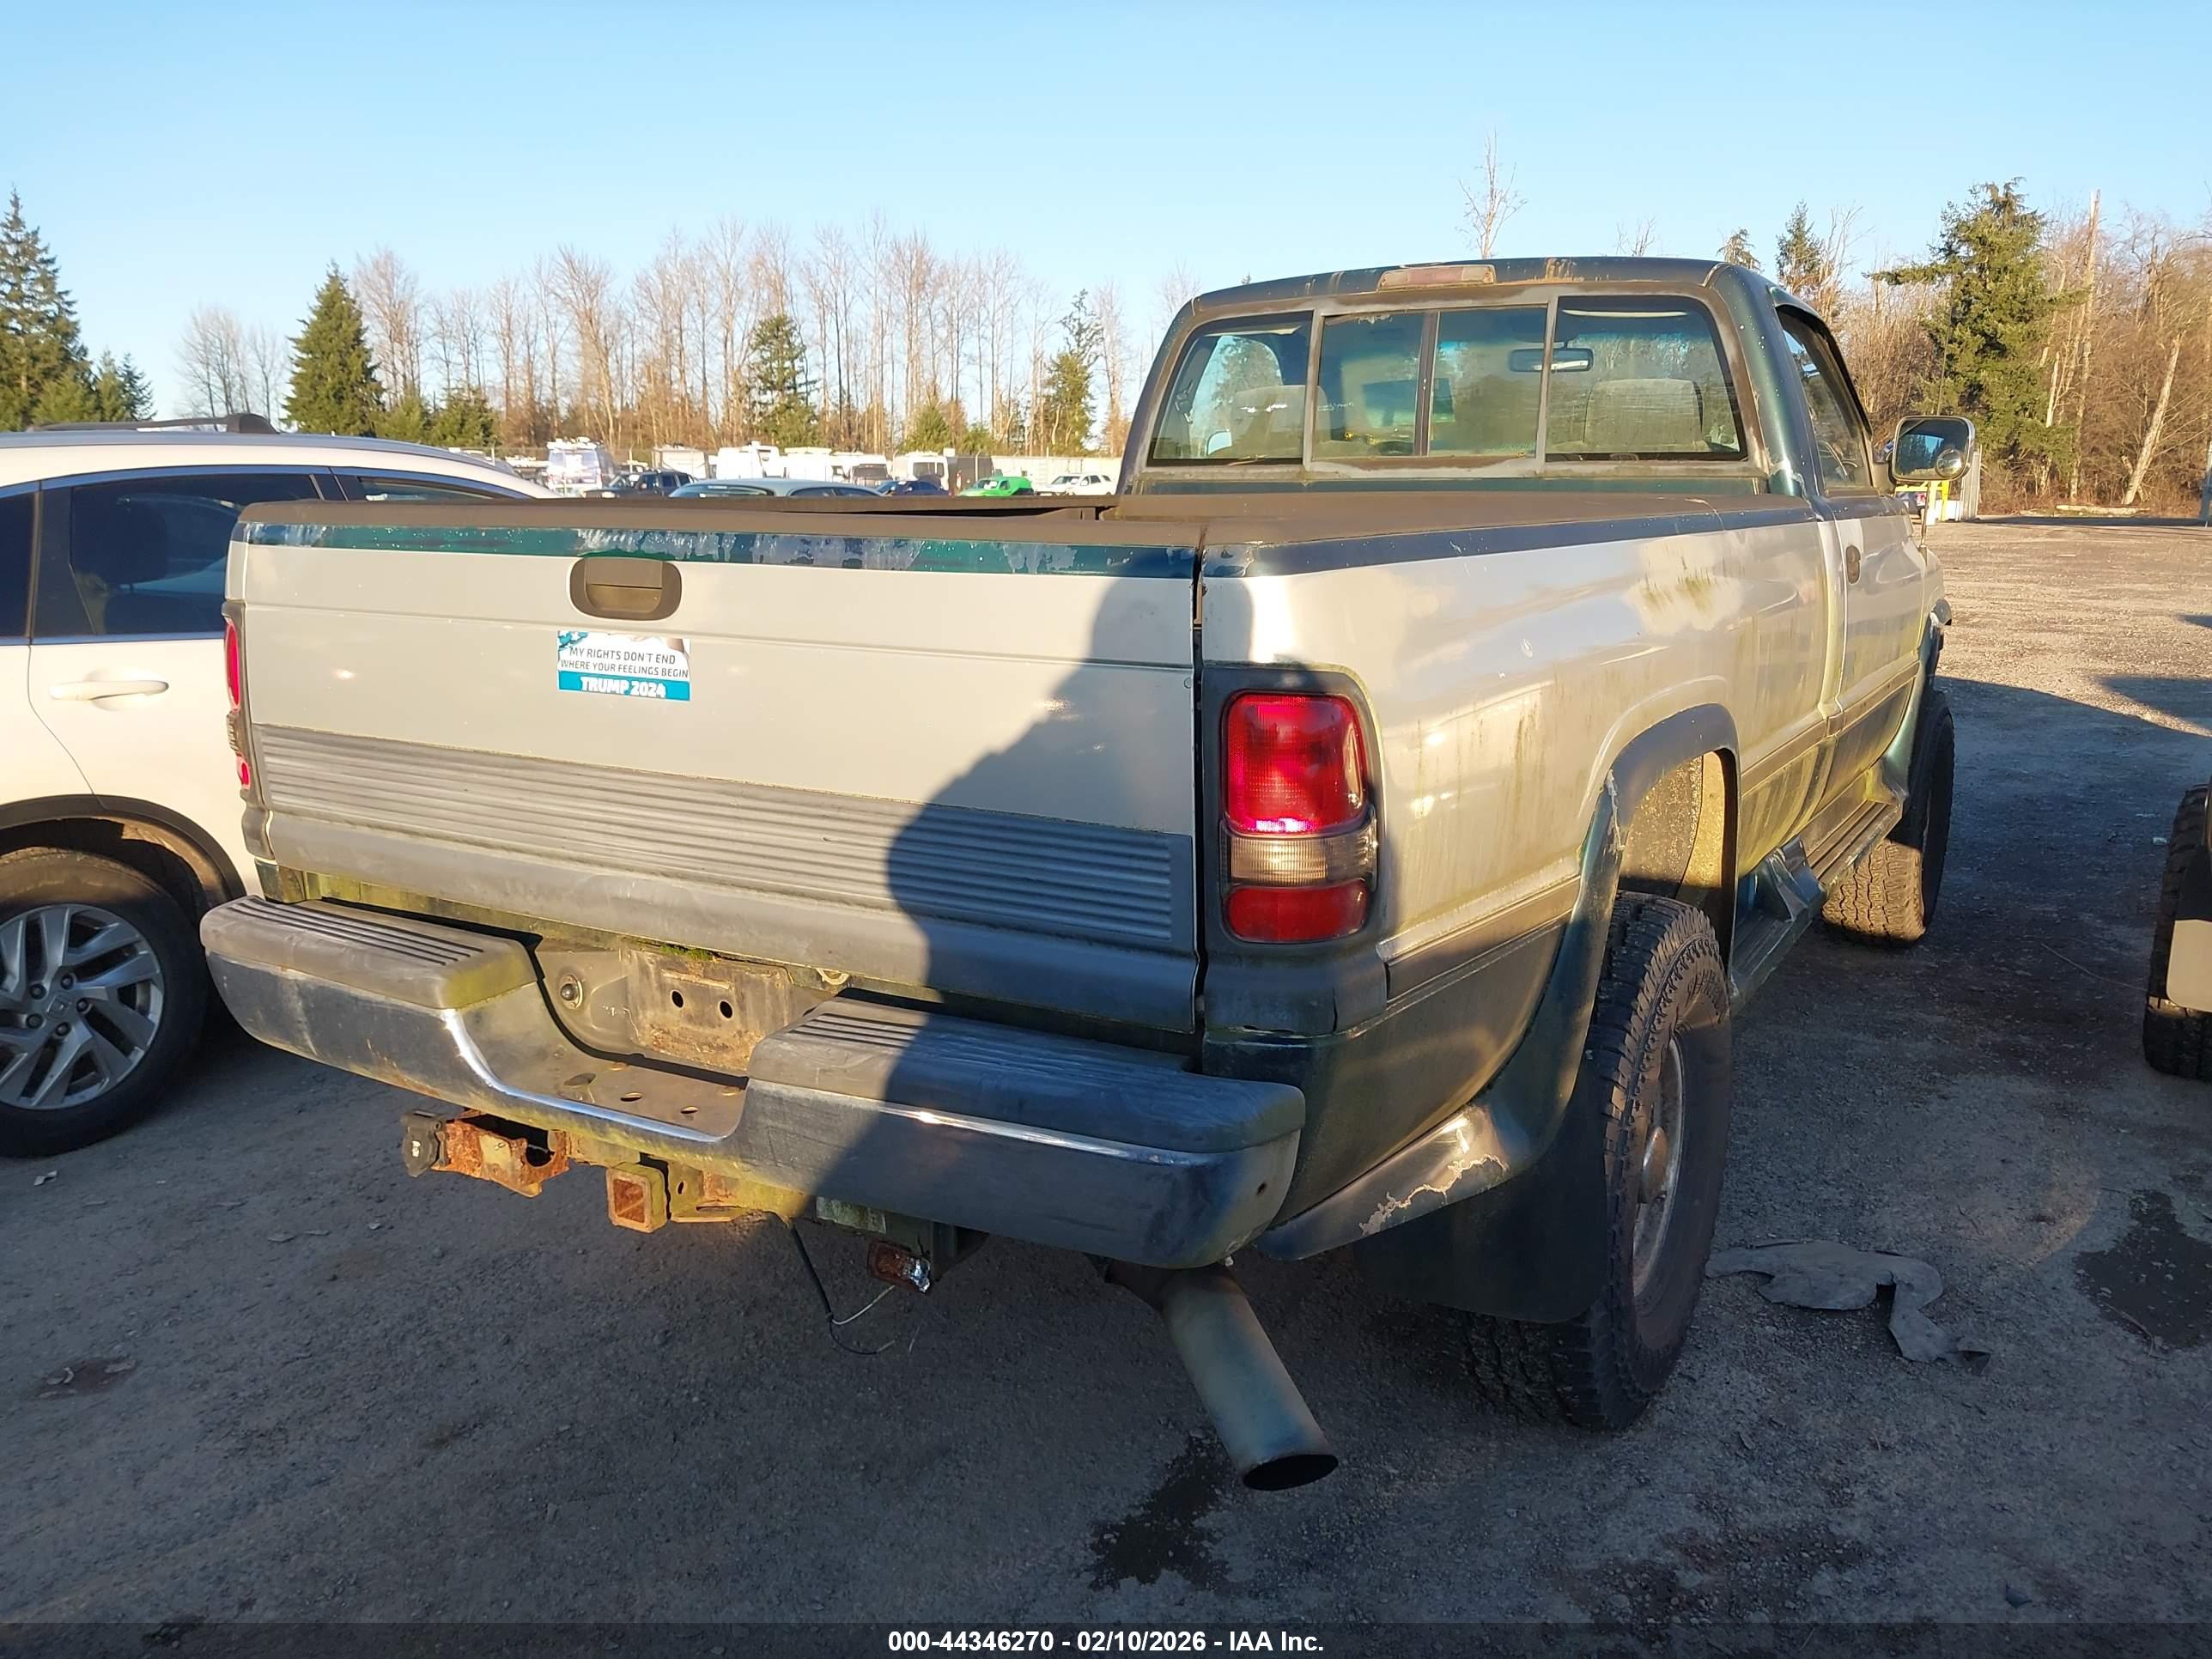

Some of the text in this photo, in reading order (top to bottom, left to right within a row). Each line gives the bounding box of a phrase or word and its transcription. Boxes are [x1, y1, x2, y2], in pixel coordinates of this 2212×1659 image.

[569, 646, 676, 665] MY RIGHTS DON'T END
[561, 659, 689, 678] WHERE YOUR FEELINGS BEGIN
[580, 677, 665, 698] TRUMP 2024
